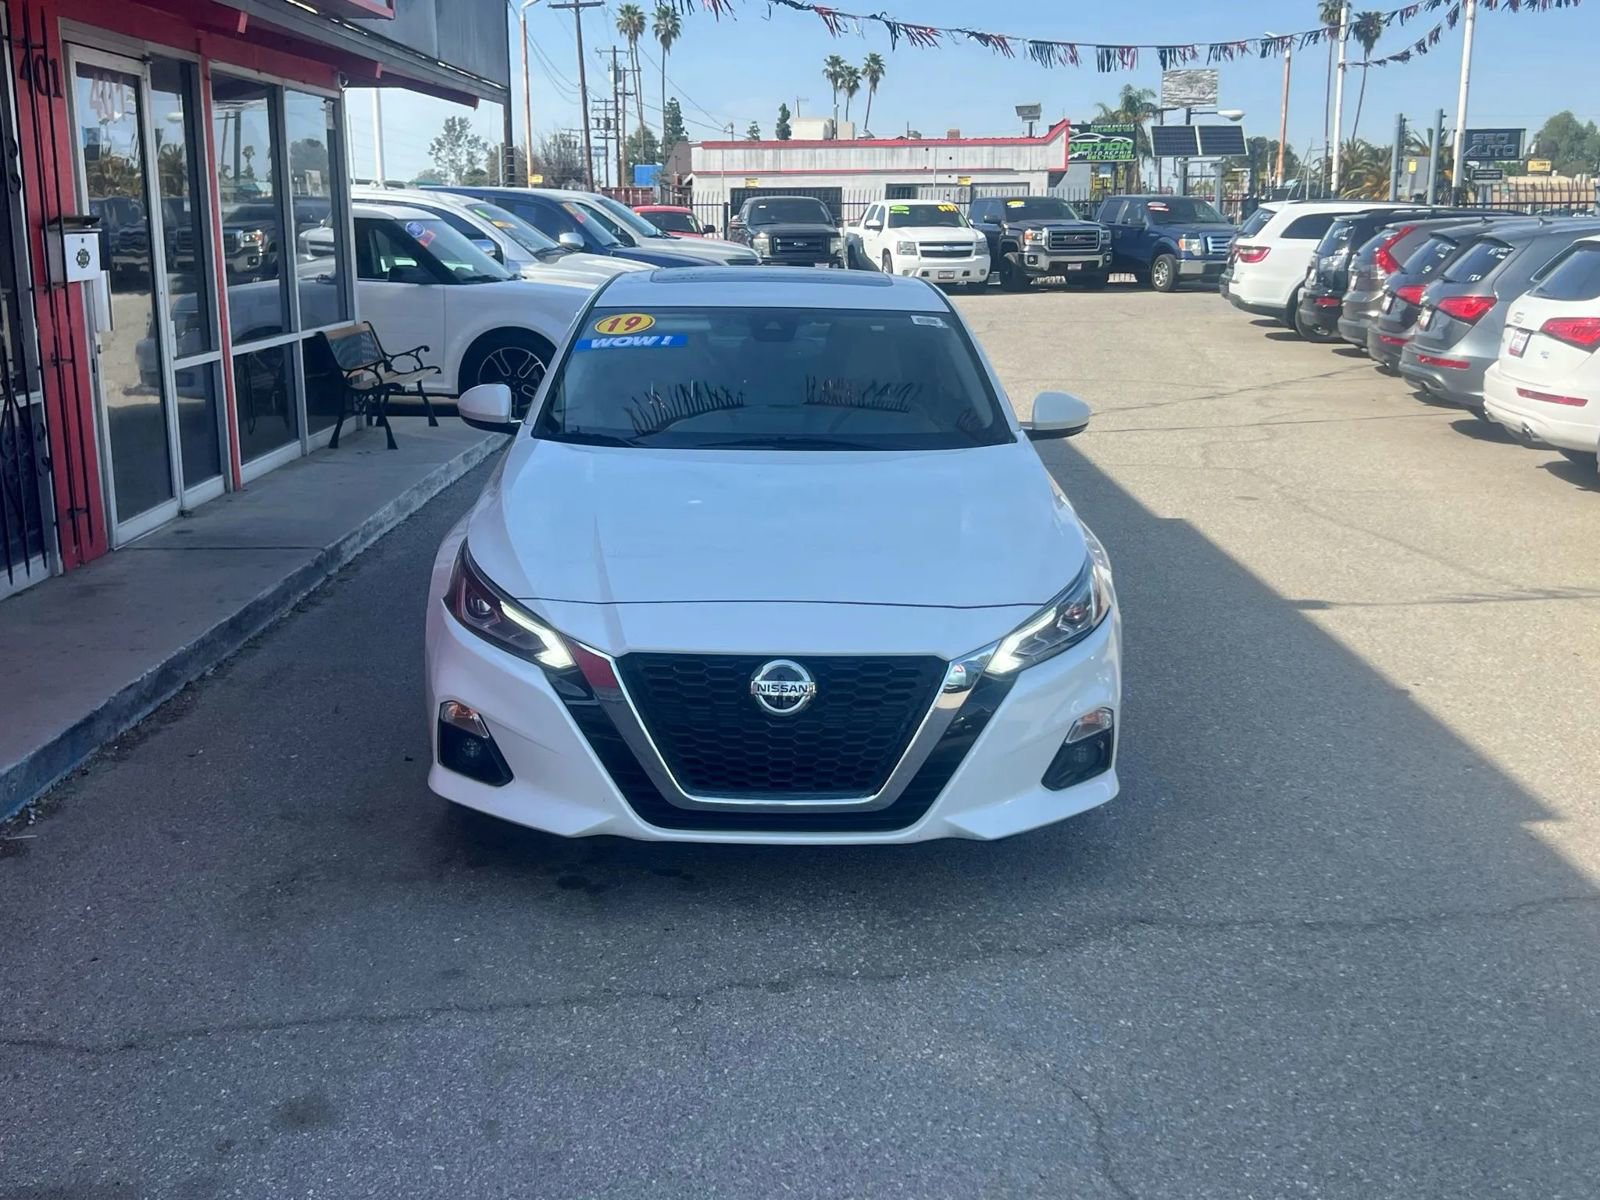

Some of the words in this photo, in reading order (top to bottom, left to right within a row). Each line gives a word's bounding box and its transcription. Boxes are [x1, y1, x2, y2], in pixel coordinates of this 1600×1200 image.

[19, 48, 63, 98] 401
[1464, 144, 1515, 157] AUTO
[607, 316, 642, 332] 19
[757, 684, 808, 693] NISSAN
